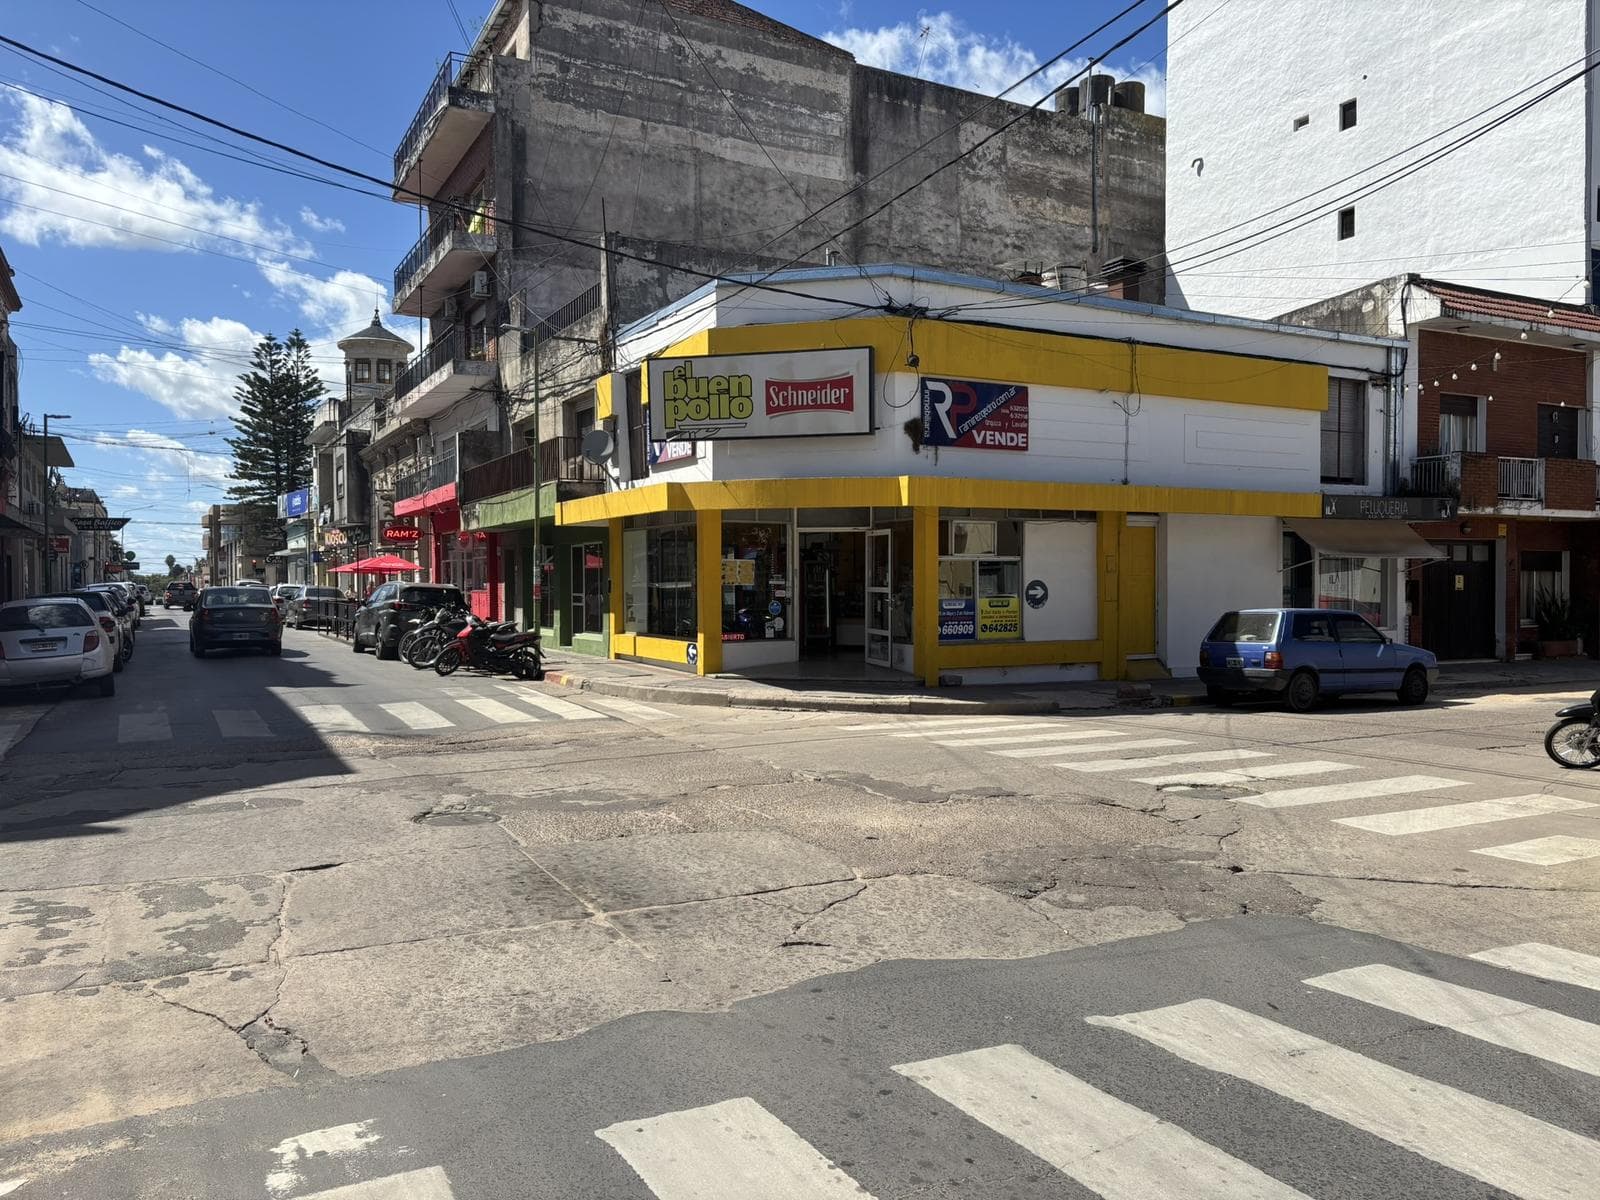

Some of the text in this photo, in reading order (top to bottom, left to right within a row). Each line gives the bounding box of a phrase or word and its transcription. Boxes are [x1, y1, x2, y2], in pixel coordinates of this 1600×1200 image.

[672, 360, 693, 378] el
[663, 370, 753, 400] buen
[769, 383, 850, 408] Schneider
[664, 393, 754, 430] pollo
[971, 429, 1028, 448] VENDE
[942, 624, 974, 635] 660909
